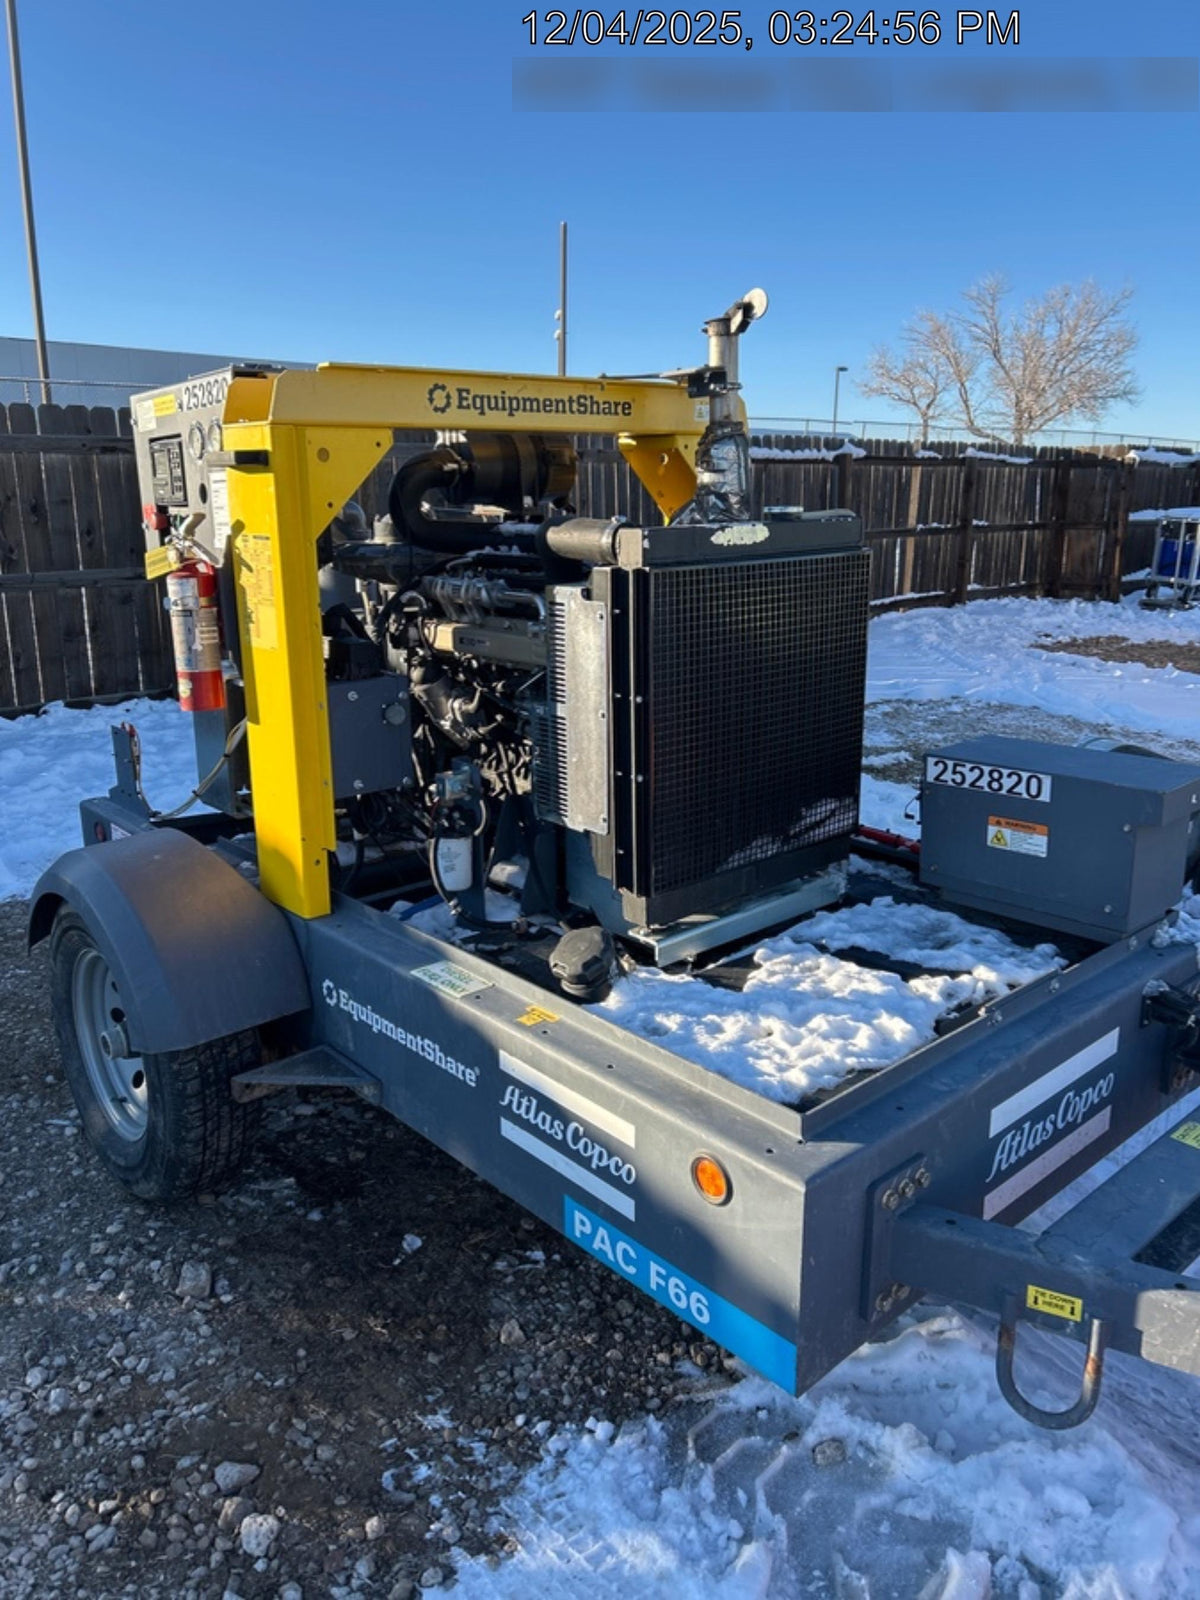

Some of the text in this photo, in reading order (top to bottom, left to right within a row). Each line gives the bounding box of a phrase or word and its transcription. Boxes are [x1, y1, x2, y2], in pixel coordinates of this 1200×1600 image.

[456, 388, 632, 417] EquipmentShare
[933, 760, 1043, 799] 252820
[338, 989, 478, 1088] EquipmentShare
[573, 1209, 711, 1325] PAC F66
